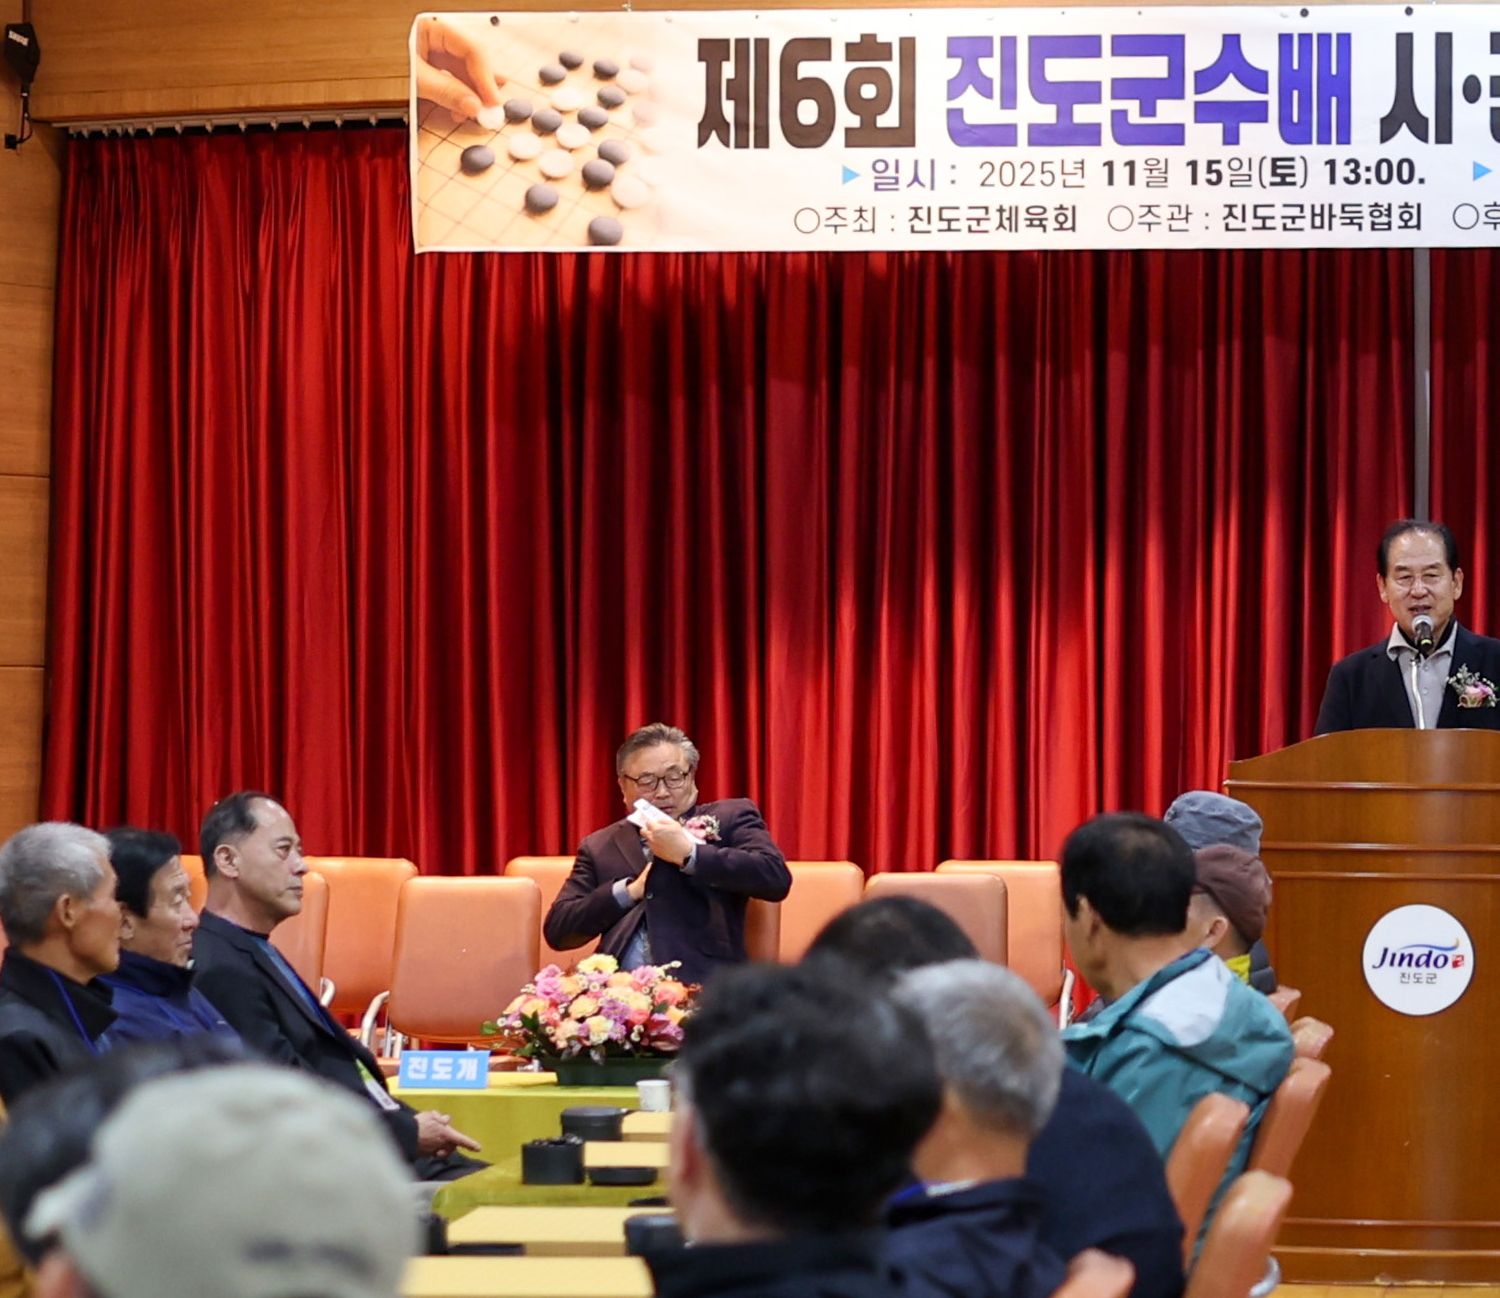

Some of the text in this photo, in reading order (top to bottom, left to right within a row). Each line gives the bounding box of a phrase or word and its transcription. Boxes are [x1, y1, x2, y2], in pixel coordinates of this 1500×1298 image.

[697, 33, 916, 149] 제6회
[946, 32, 1352, 148] 진도군수배
[871, 158, 936, 192] 일시
[979, 159, 1086, 190] 2025년
[1102, 157, 1170, 188] 11월
[1185, 155, 1308, 190] 15일(토)
[1324, 157, 1426, 187] 13:00.
[907, 204, 1078, 234] 진도군체육회
[1221, 202, 1423, 233] 진도군바둑협회
[1372, 947, 1449, 969] Jindo
[1400, 972, 1437, 984] 진도군
[406, 1056, 479, 1081] 진도개
